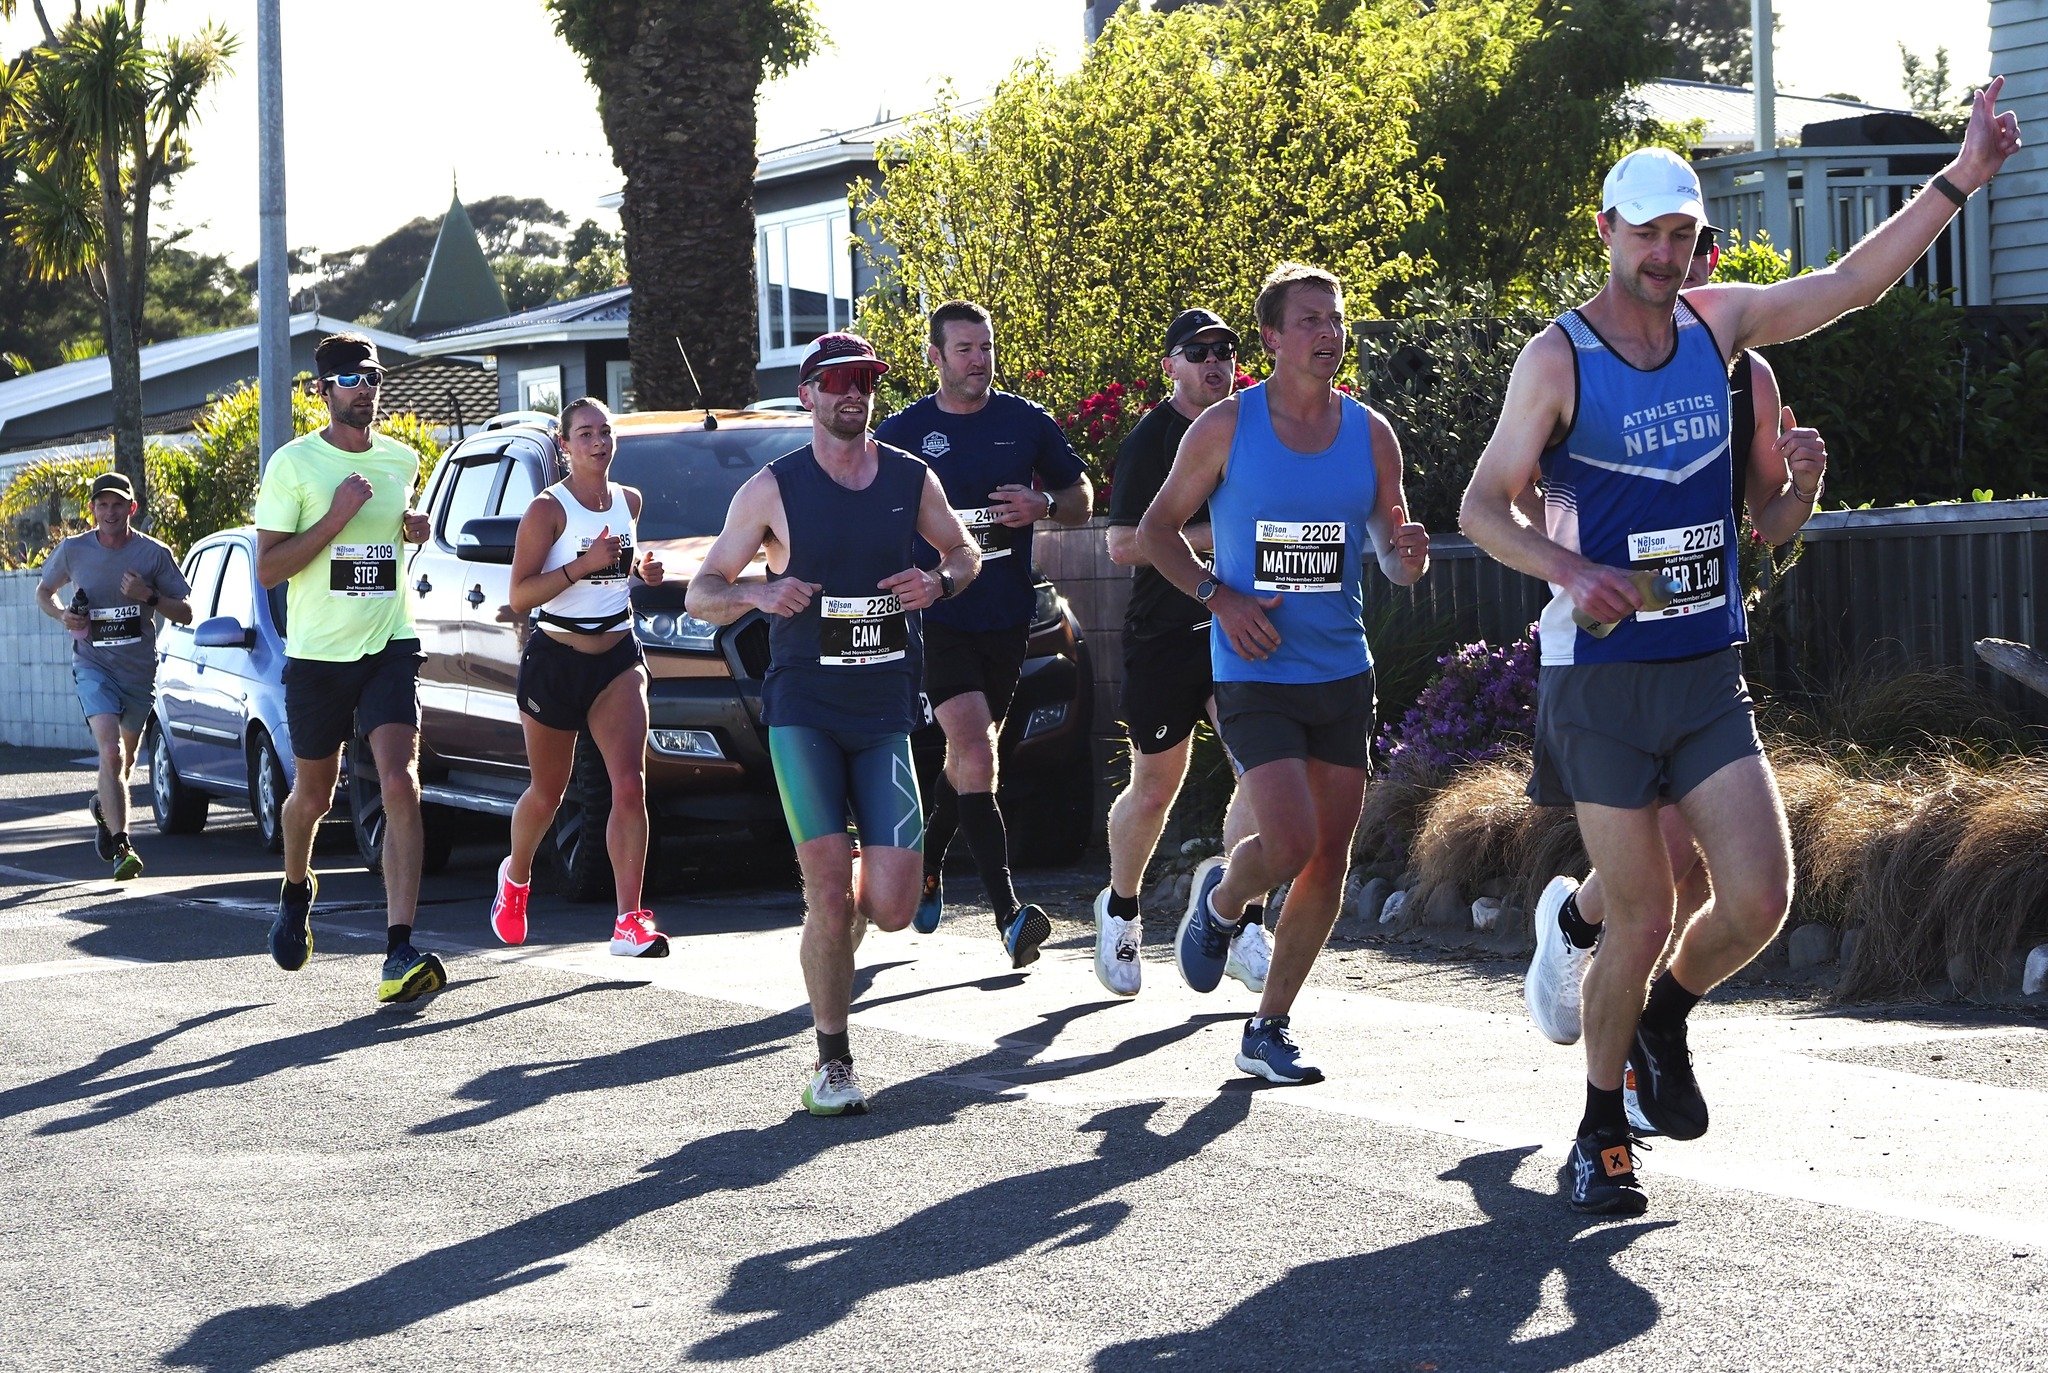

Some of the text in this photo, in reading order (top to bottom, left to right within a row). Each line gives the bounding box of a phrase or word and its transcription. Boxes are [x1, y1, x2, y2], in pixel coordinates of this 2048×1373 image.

[1623, 394, 1715, 429] ATHLETICS
[1623, 413, 1721, 457] NELSON
[975, 509, 999, 523] 24
[1263, 523, 1287, 534] Nelson
[1301, 524, 1340, 542] 2202
[1637, 536, 1666, 549] Nelson
[1683, 524, 1720, 552] 2273
[336, 545, 355, 553] Nelson
[366, 545, 393, 559] 2109
[1637, 546, 1650, 554] HALF
[1262, 550, 1338, 574] MATTYKIWI
[1665, 556, 1678, 565] Half
[1679, 553, 1704, 562] Marathon
[354, 566, 379, 584] STEP
[1694, 557, 1720, 590] 1:30
[828, 600, 852, 609] Nelson
[866, 594, 901, 616] 2288
[1672, 595, 1700, 605] November
[114, 606, 138, 618] 2442
[100, 624, 126, 632] NOVA
[852, 624, 881, 648] CAM
